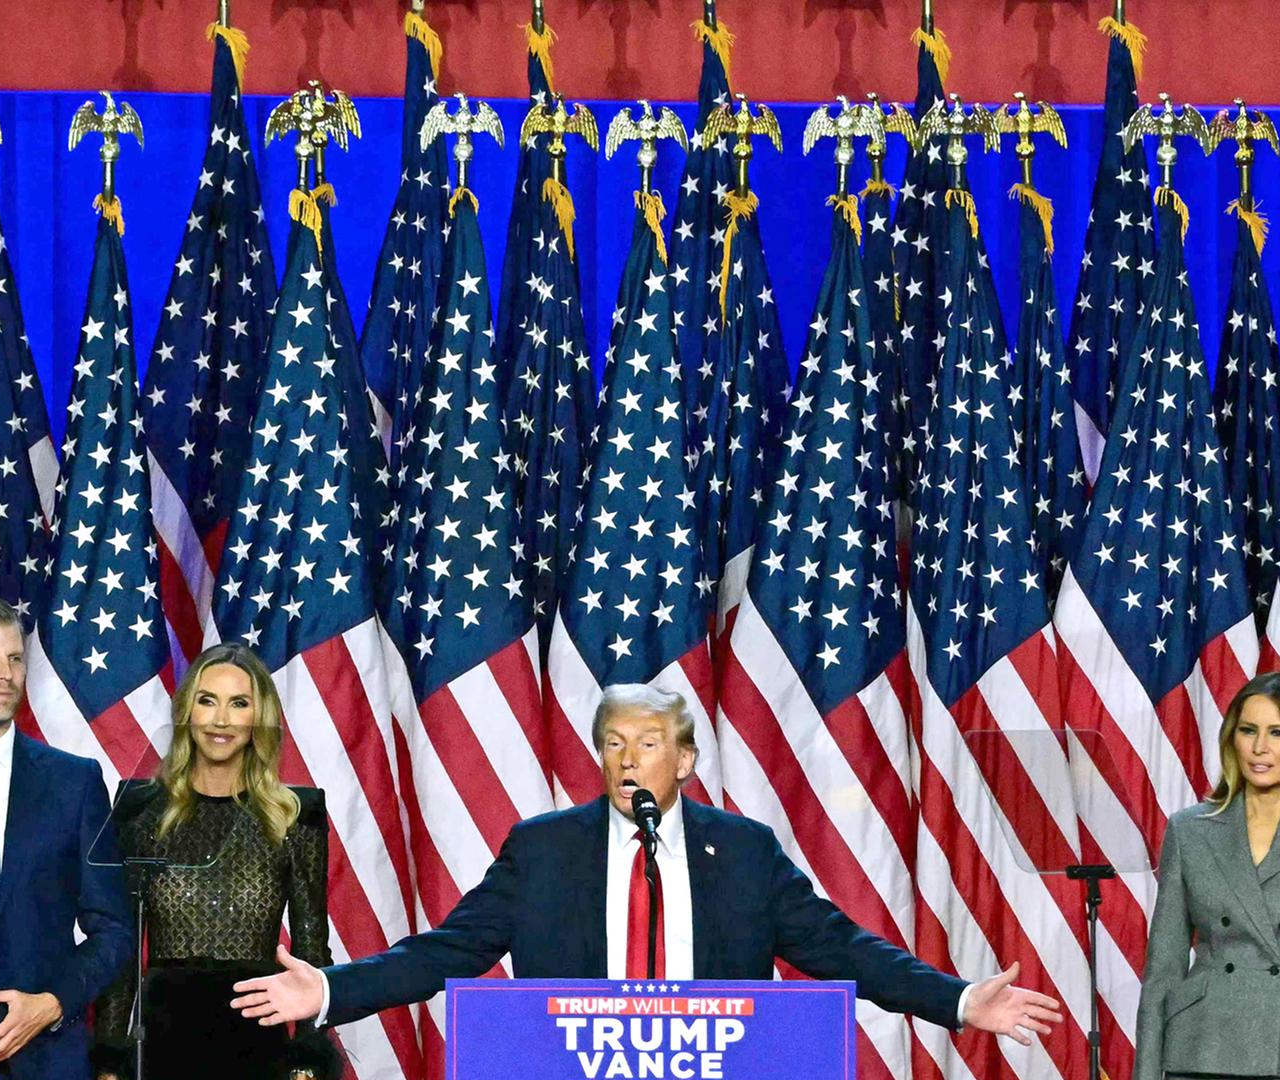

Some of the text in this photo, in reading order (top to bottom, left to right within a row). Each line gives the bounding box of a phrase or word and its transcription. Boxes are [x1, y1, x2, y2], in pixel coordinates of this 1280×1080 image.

[556, 998, 745, 1015] TRUMP WILL FIX IT
[556, 1017, 745, 1051] TRUMP
[577, 1051, 724, 1079] VANCE
